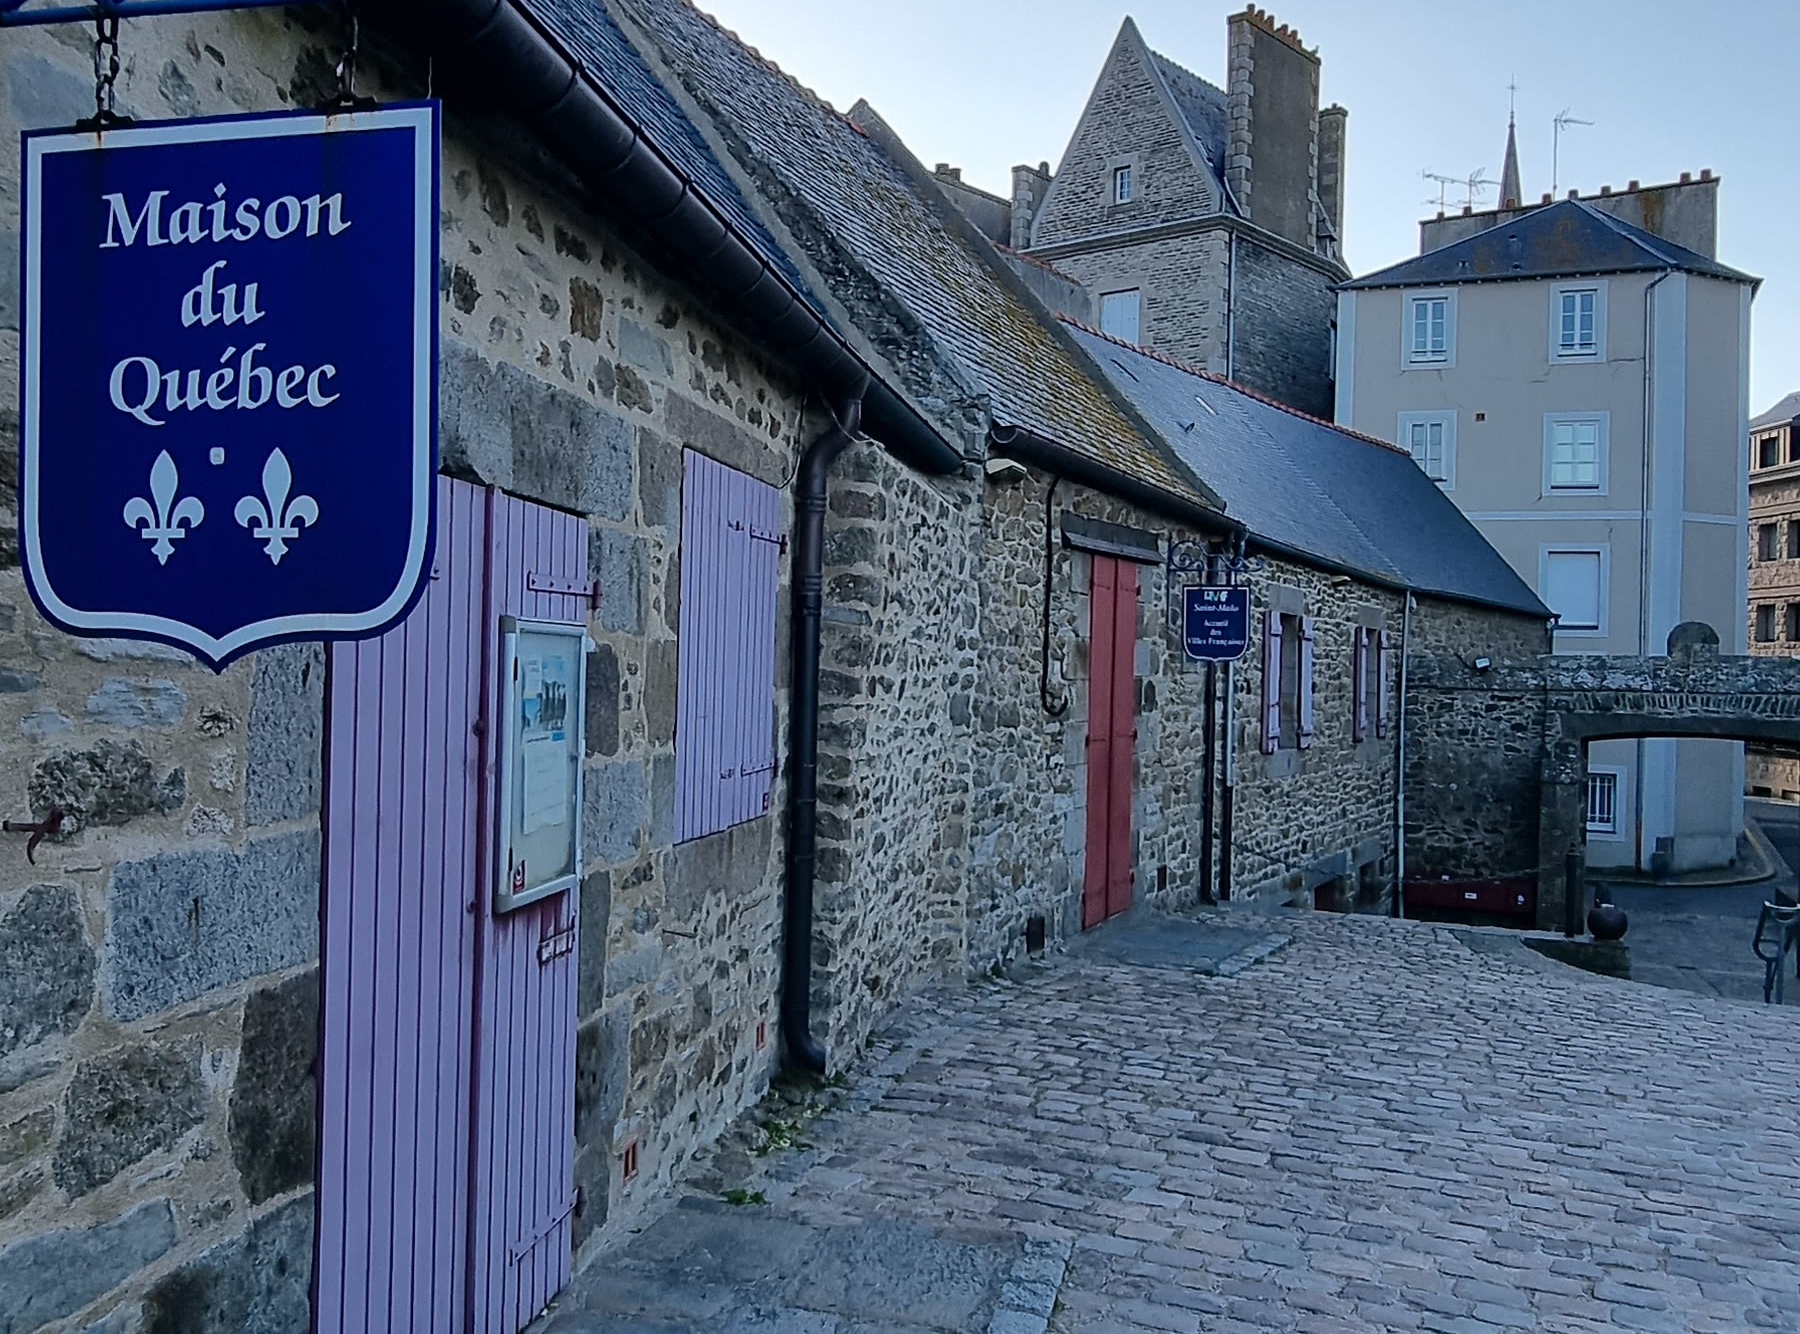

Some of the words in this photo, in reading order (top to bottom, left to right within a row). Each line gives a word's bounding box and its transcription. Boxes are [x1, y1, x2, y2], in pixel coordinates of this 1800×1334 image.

[99, 182, 352, 249] Maison
[181, 260, 266, 328] du
[109, 343, 341, 426] Québec
[1193, 603, 1240, 612] Saint-Malo
[1203, 619, 1229, 627] Accueil
[1210, 628, 1222, 636] des
[1187, 637, 1207, 645] Villes
[1208, 637, 1245, 646] Françaises
